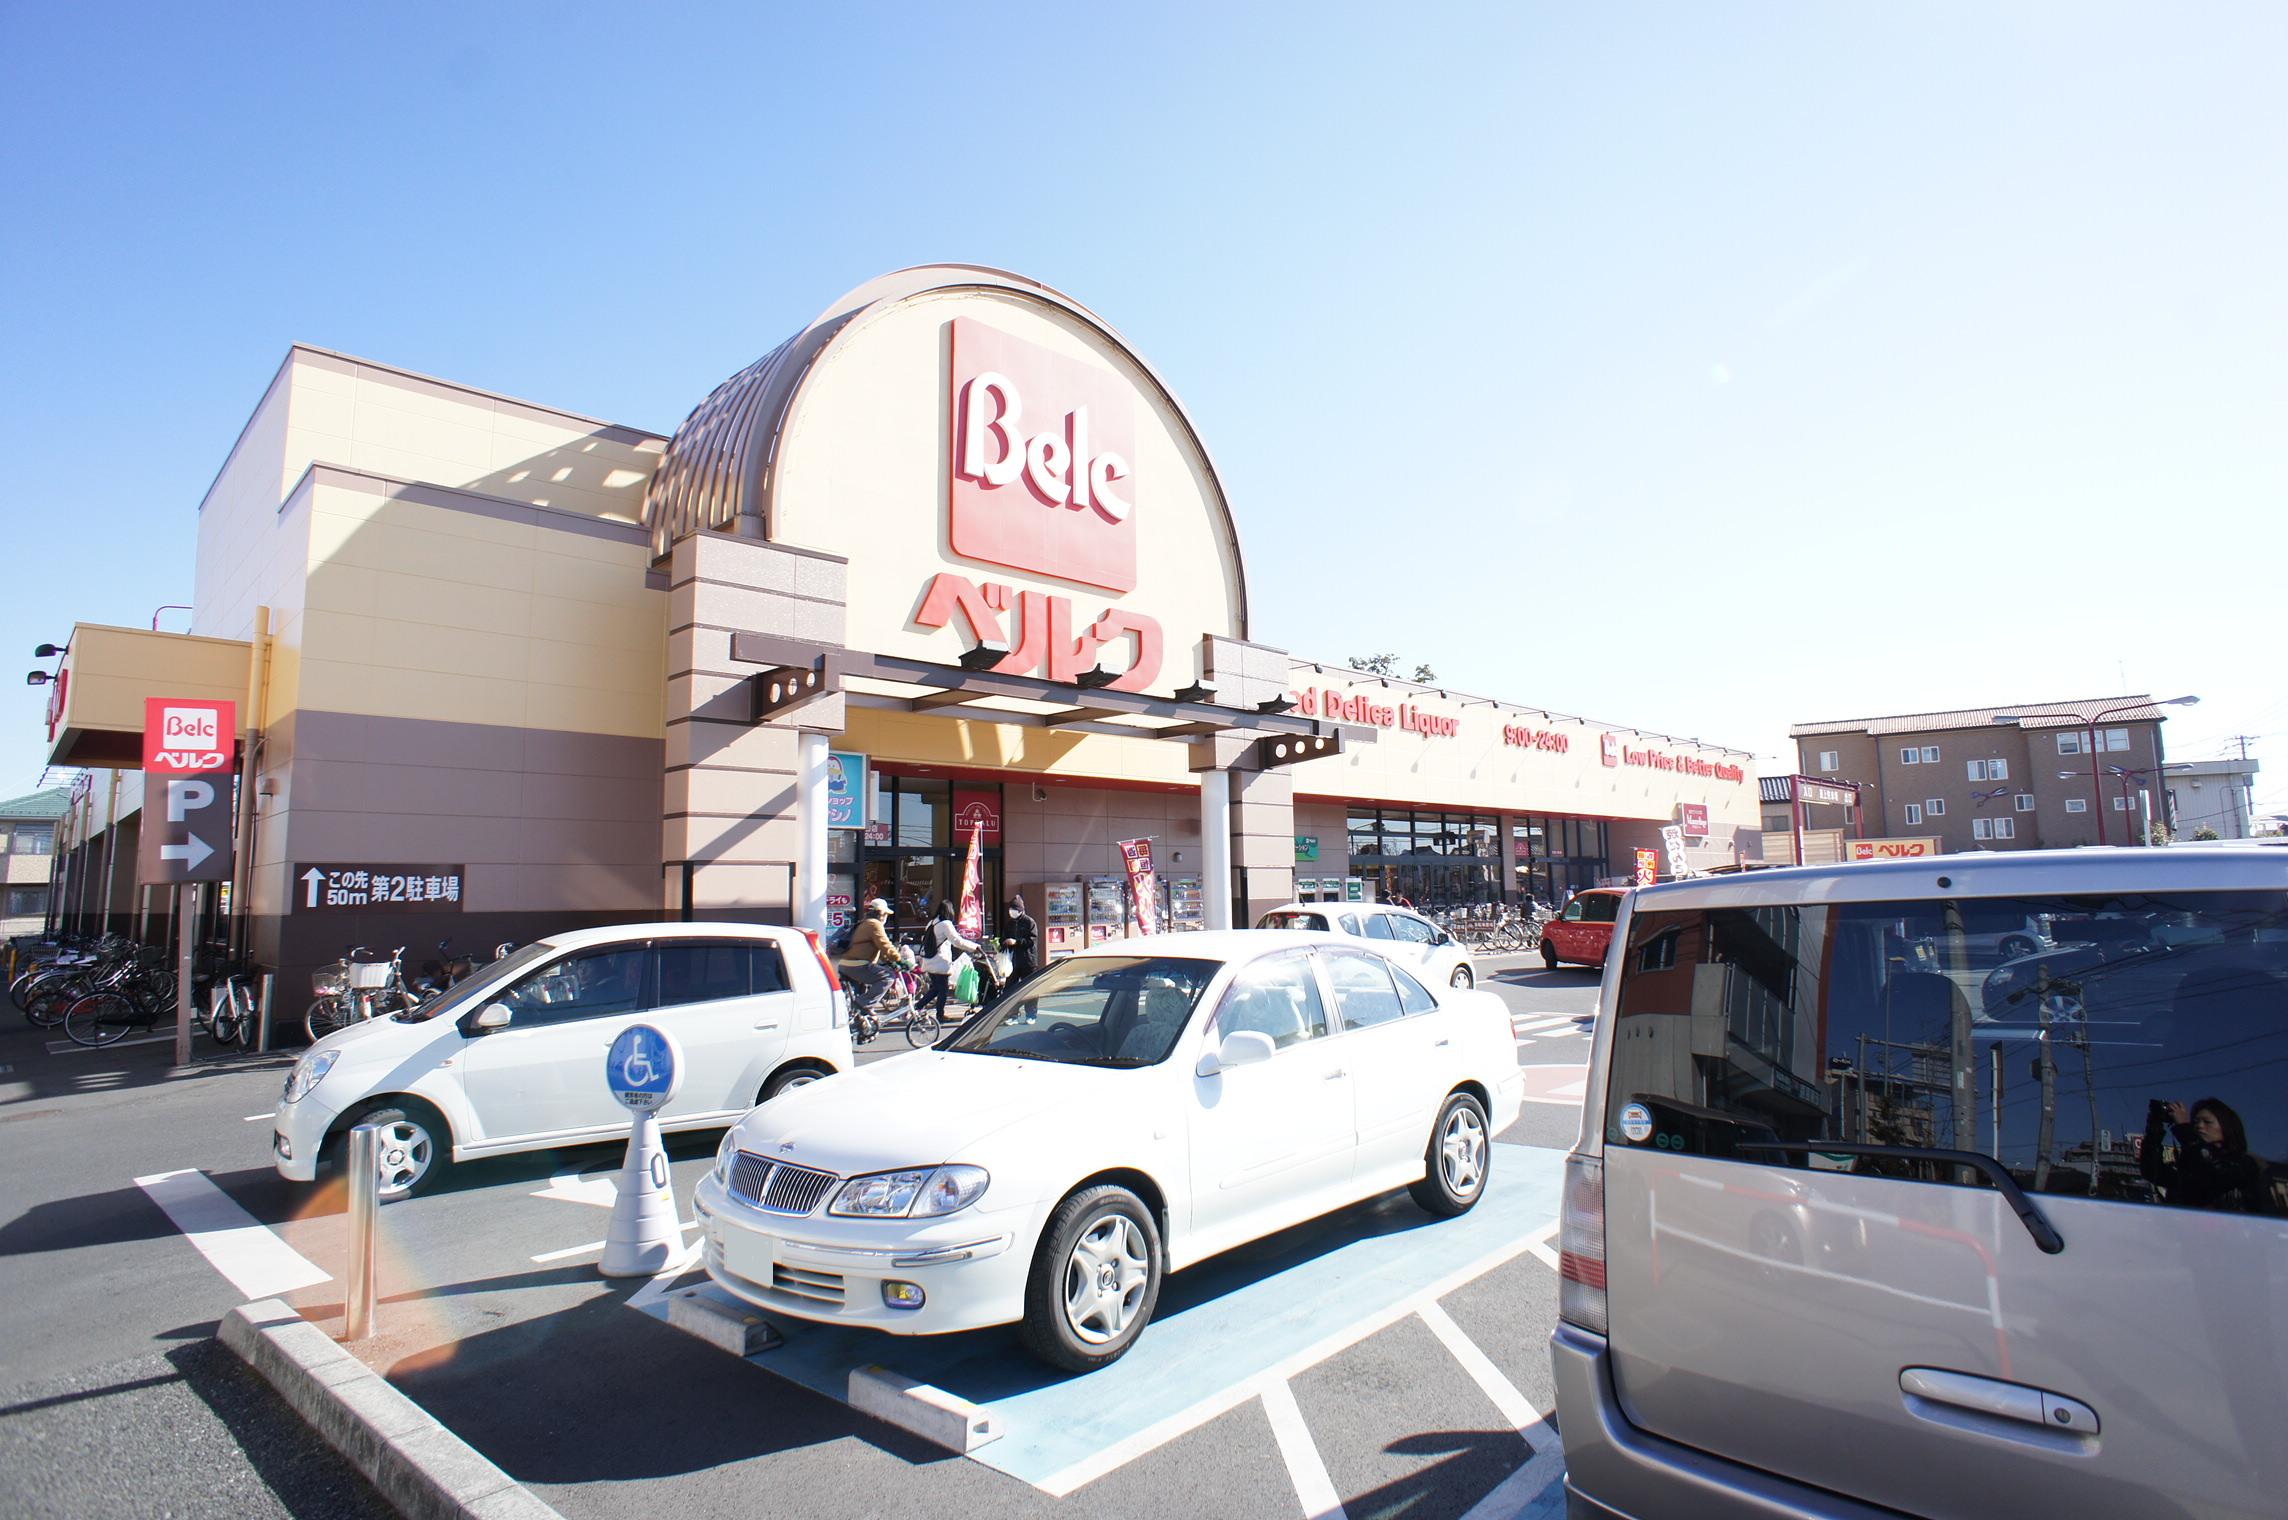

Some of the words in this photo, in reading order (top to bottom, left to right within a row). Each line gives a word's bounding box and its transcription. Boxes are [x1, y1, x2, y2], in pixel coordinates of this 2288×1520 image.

[914, 572, 1164, 693] ベルク
[166, 716, 215, 737] Belc
[1323, 689, 1395, 727] Delica
[1400, 703, 1460, 738] Liquor
[154, 752, 225, 769] ベルク
[1623, 745, 1646, 766] Low
[1648, 749, 1673, 771] Price
[1676, 755, 1683, 773] &
[1685, 756, 1713, 778] Better
[1715, 762, 1744, 784] Quality
[167, 780, 215, 822] P
[959, 819, 996, 827] TOPALU
[1879, 843, 1925, 857] ベルク
[327, 889, 368, 905] 50m
[329, 871, 369, 889] この先
[371, 875, 460, 902] 第2駐車場
